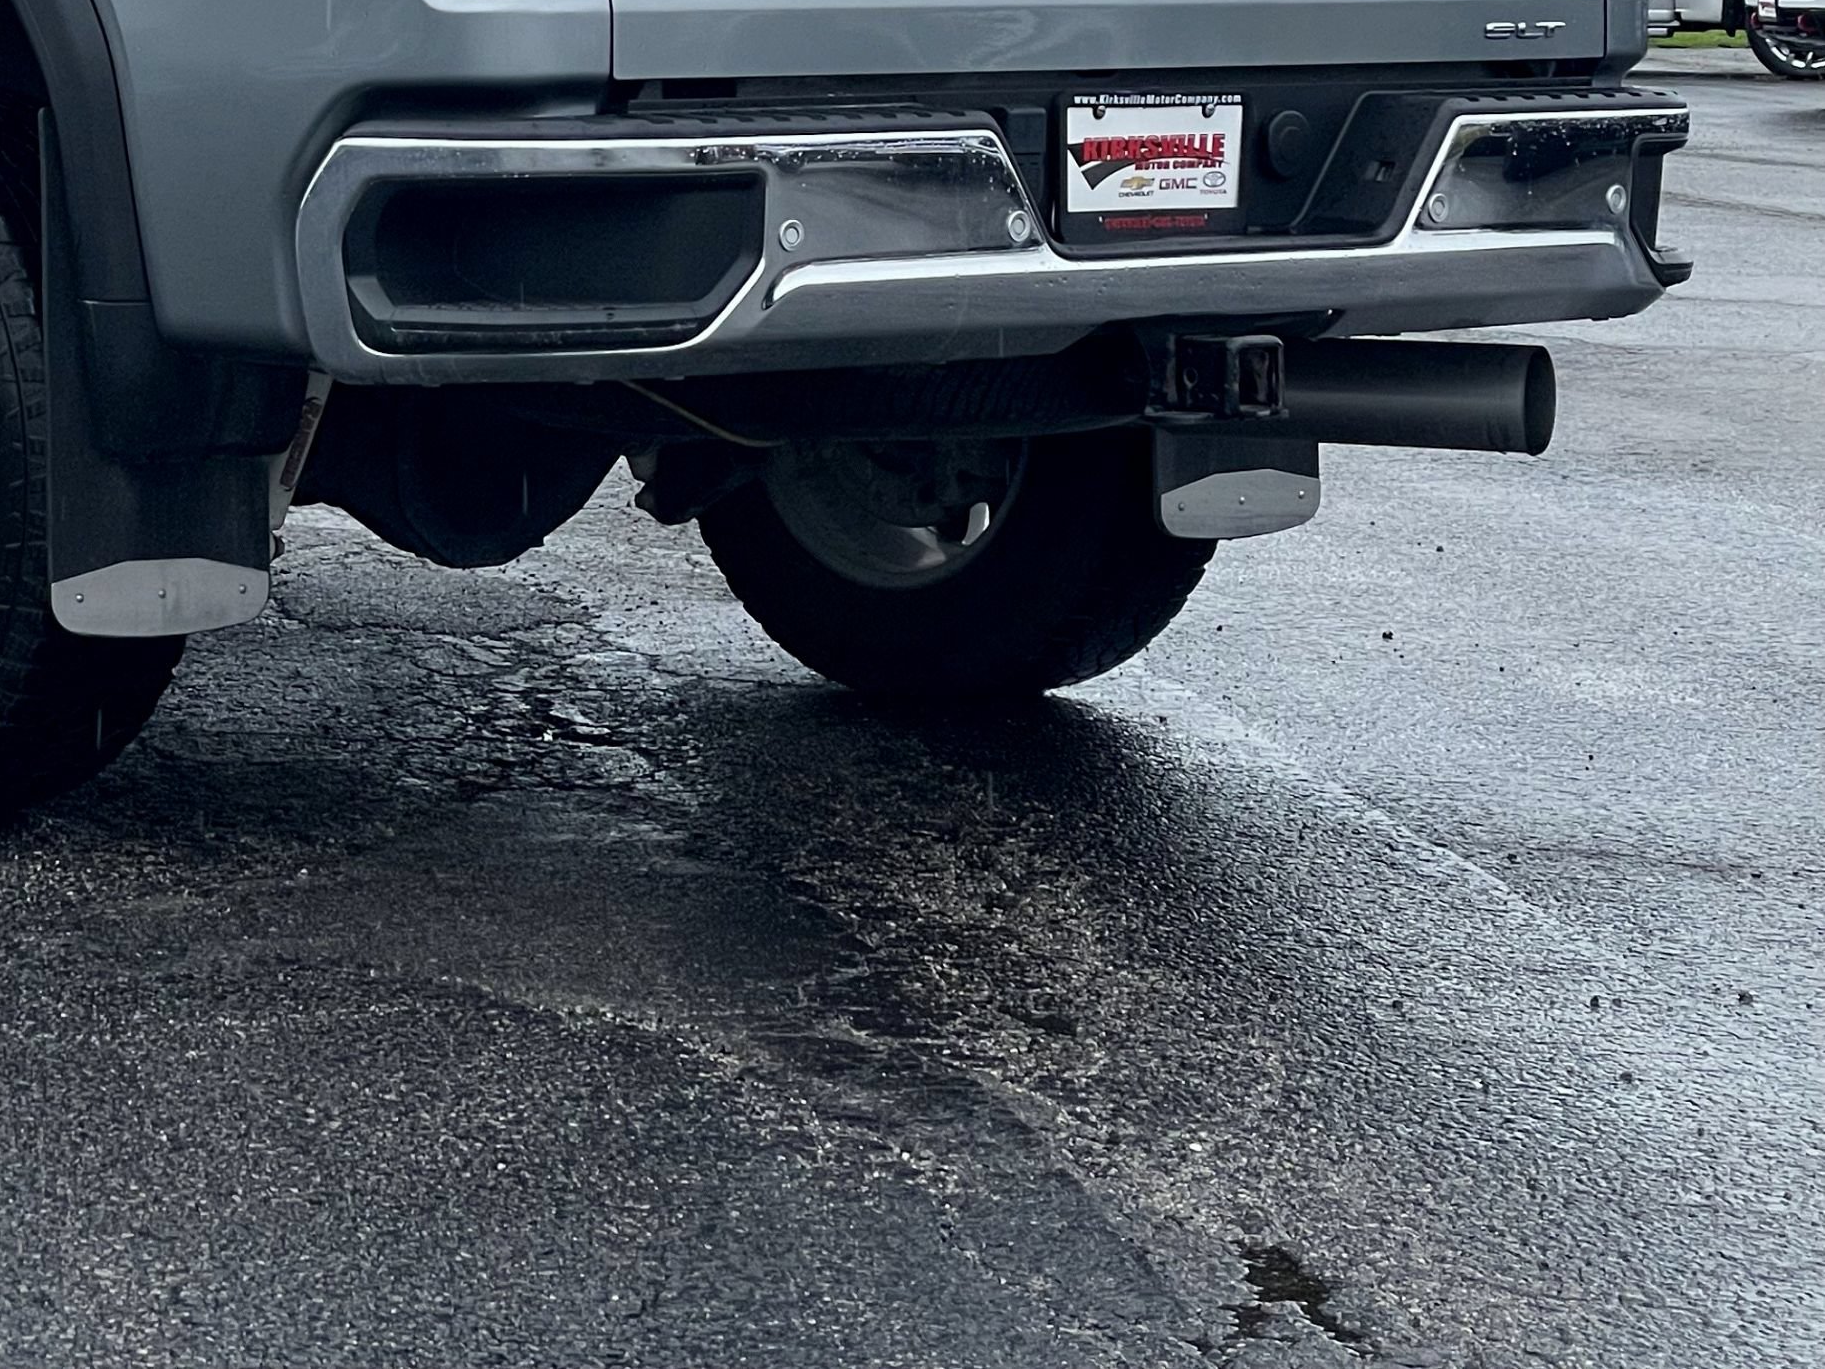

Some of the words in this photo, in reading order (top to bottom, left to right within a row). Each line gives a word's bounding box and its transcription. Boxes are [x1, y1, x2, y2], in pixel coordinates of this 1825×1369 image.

[1484, 21, 1566, 39] SLT
[1074, 94, 1242, 105] www.KirksvilleMotorCompany.com
[1083, 134, 1225, 161] KIRKSVILLE
[1135, 161, 1170, 170] MOTOR
[1173, 159, 1223, 169] COMPANY
[1159, 178, 1198, 190] GMC
